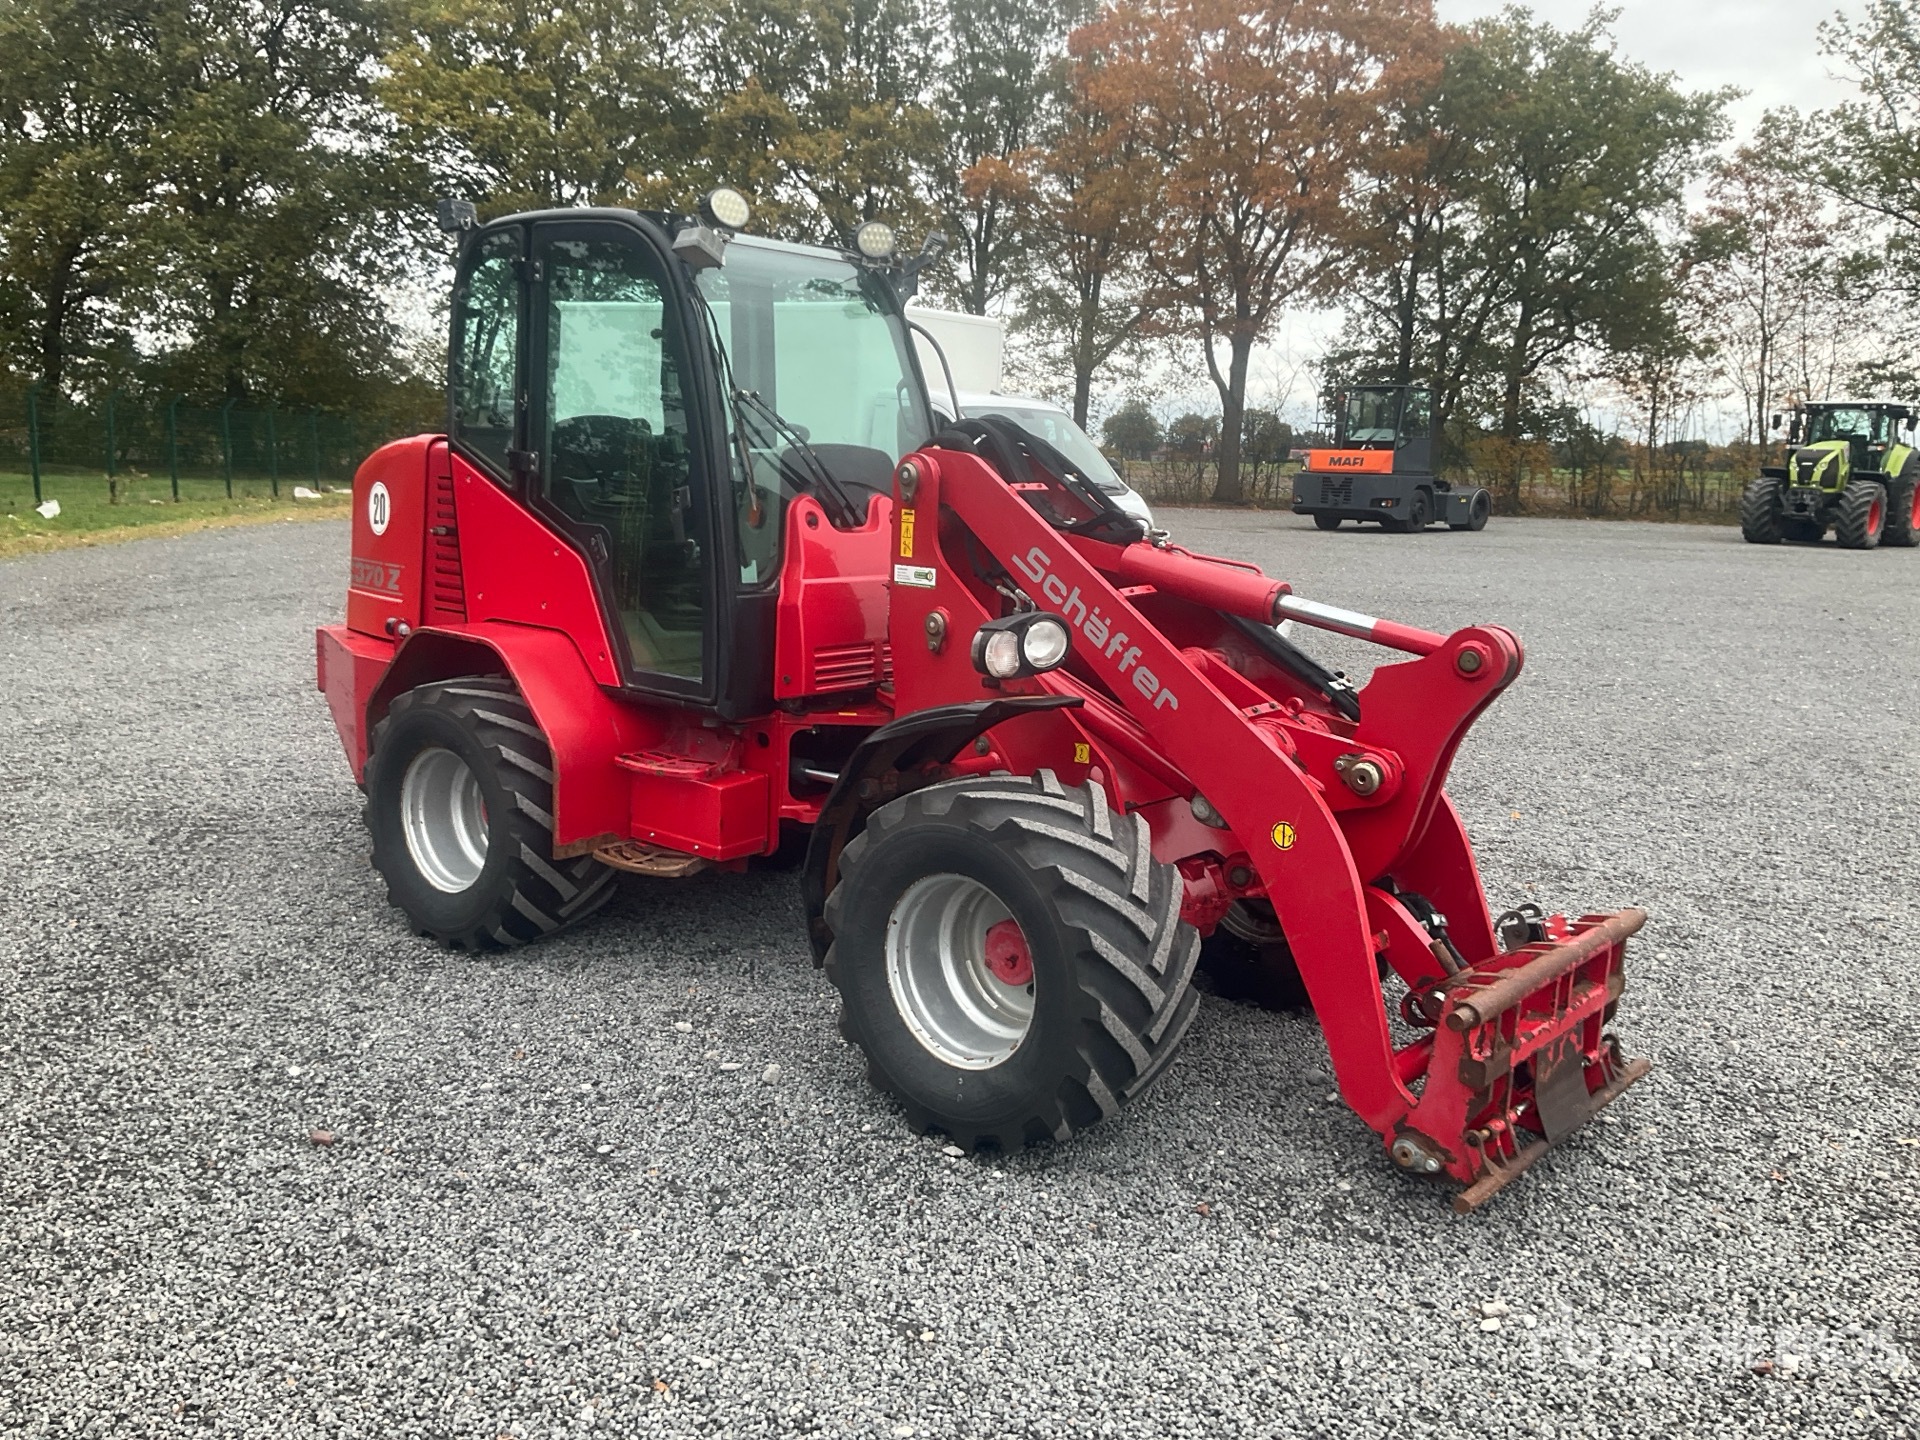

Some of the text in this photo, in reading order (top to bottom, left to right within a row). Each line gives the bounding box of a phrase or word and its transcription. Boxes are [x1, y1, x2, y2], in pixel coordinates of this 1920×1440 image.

[1328, 456, 1365, 467] MAFI
[373, 492, 386, 526] 20
[351, 561, 401, 591] 370 Z
[1011, 546, 1179, 711] Schäffer
